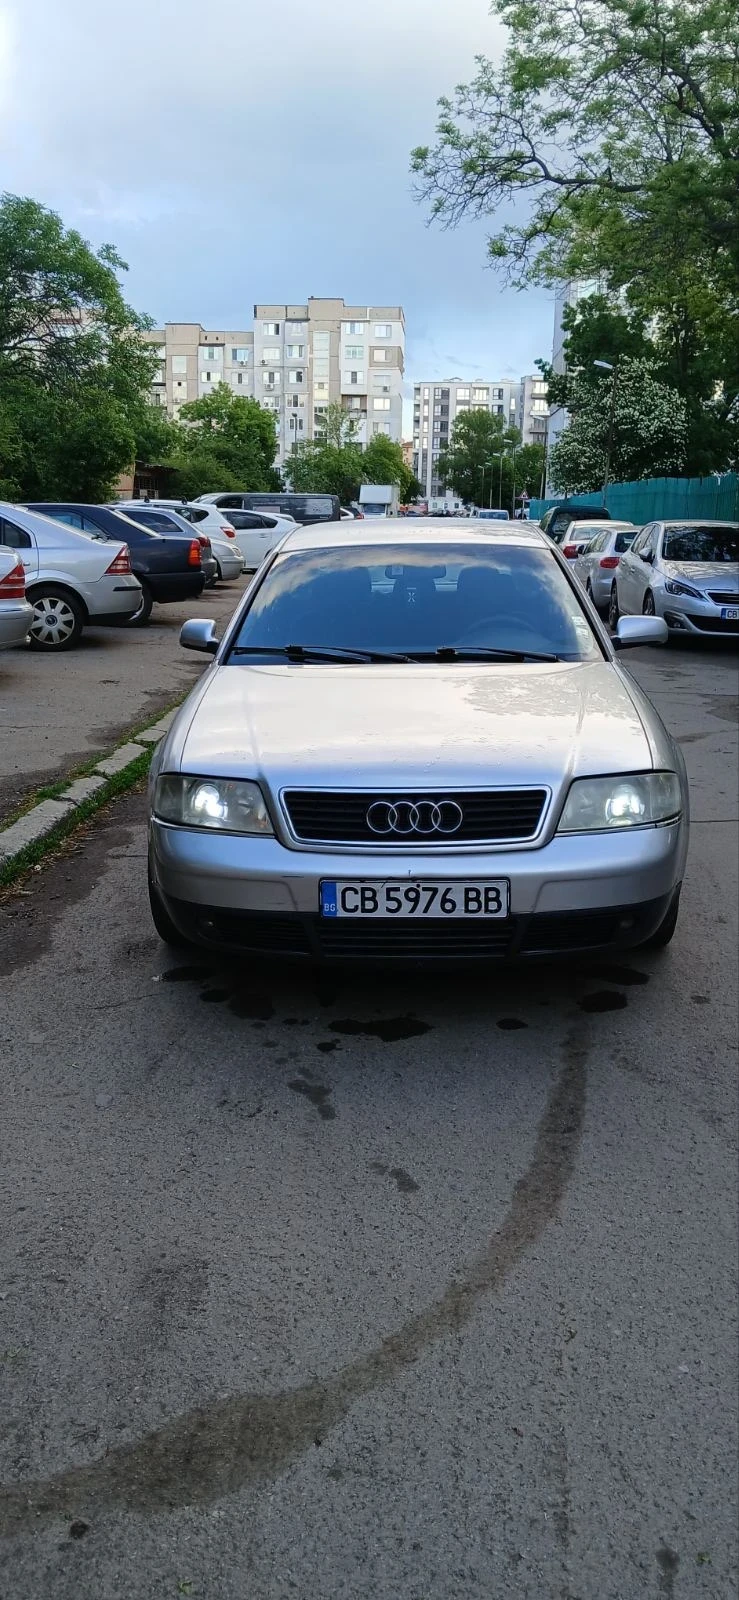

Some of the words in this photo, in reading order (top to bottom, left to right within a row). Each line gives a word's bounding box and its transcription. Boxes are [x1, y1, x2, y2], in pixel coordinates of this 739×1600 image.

[324, 903, 336, 912] BG
[340, 886, 379, 914] CB
[385, 887, 457, 914] 5976
[463, 887, 503, 914] BB
